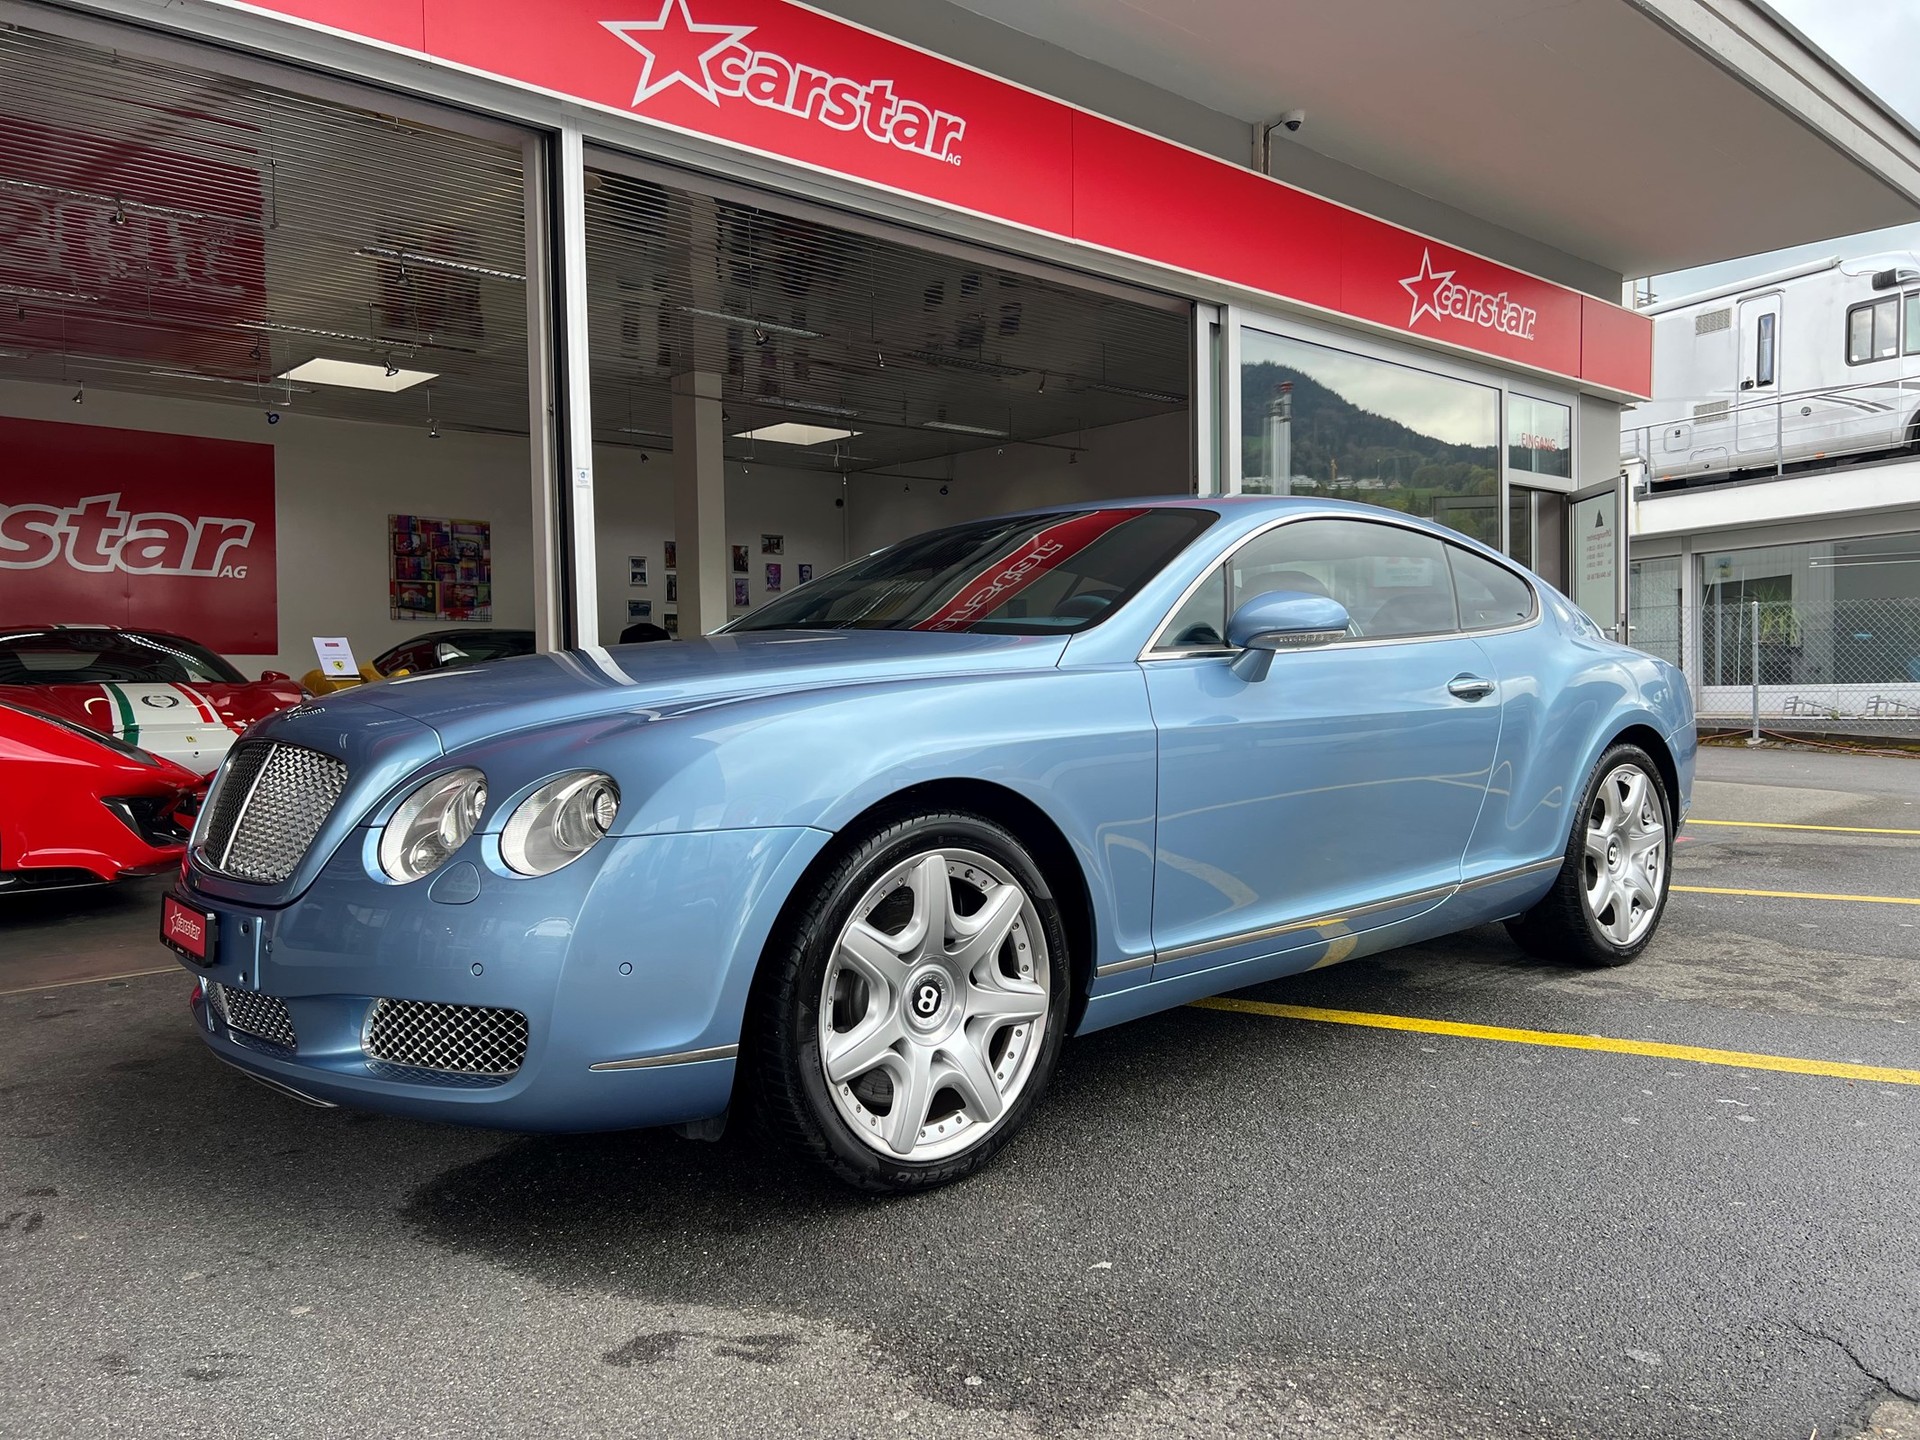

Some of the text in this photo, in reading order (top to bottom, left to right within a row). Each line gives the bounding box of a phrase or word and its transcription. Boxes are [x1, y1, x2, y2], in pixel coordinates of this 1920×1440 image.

[706, 42, 967, 167] carstar AG
[1436, 281, 1537, 340] carstar
[1521, 432, 1557, 452] EINGANG
[0, 492, 256, 579] star AG
